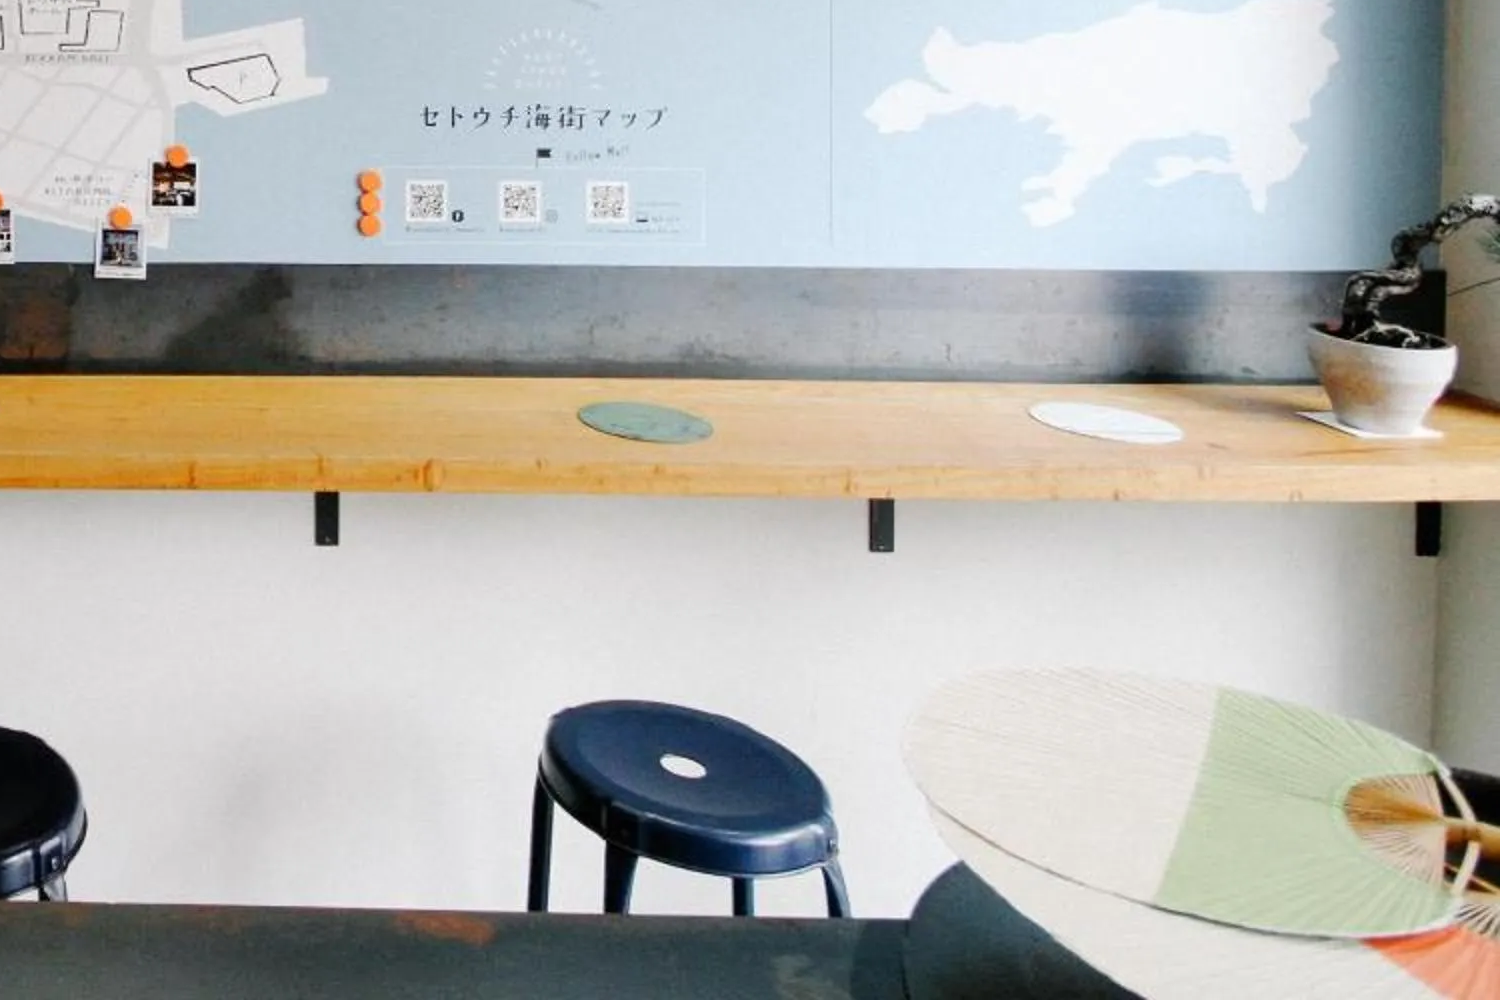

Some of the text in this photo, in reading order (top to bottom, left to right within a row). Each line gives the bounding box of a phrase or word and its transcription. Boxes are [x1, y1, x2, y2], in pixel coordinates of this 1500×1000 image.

[420, 103, 668, 131] セトウチ海街マップ
